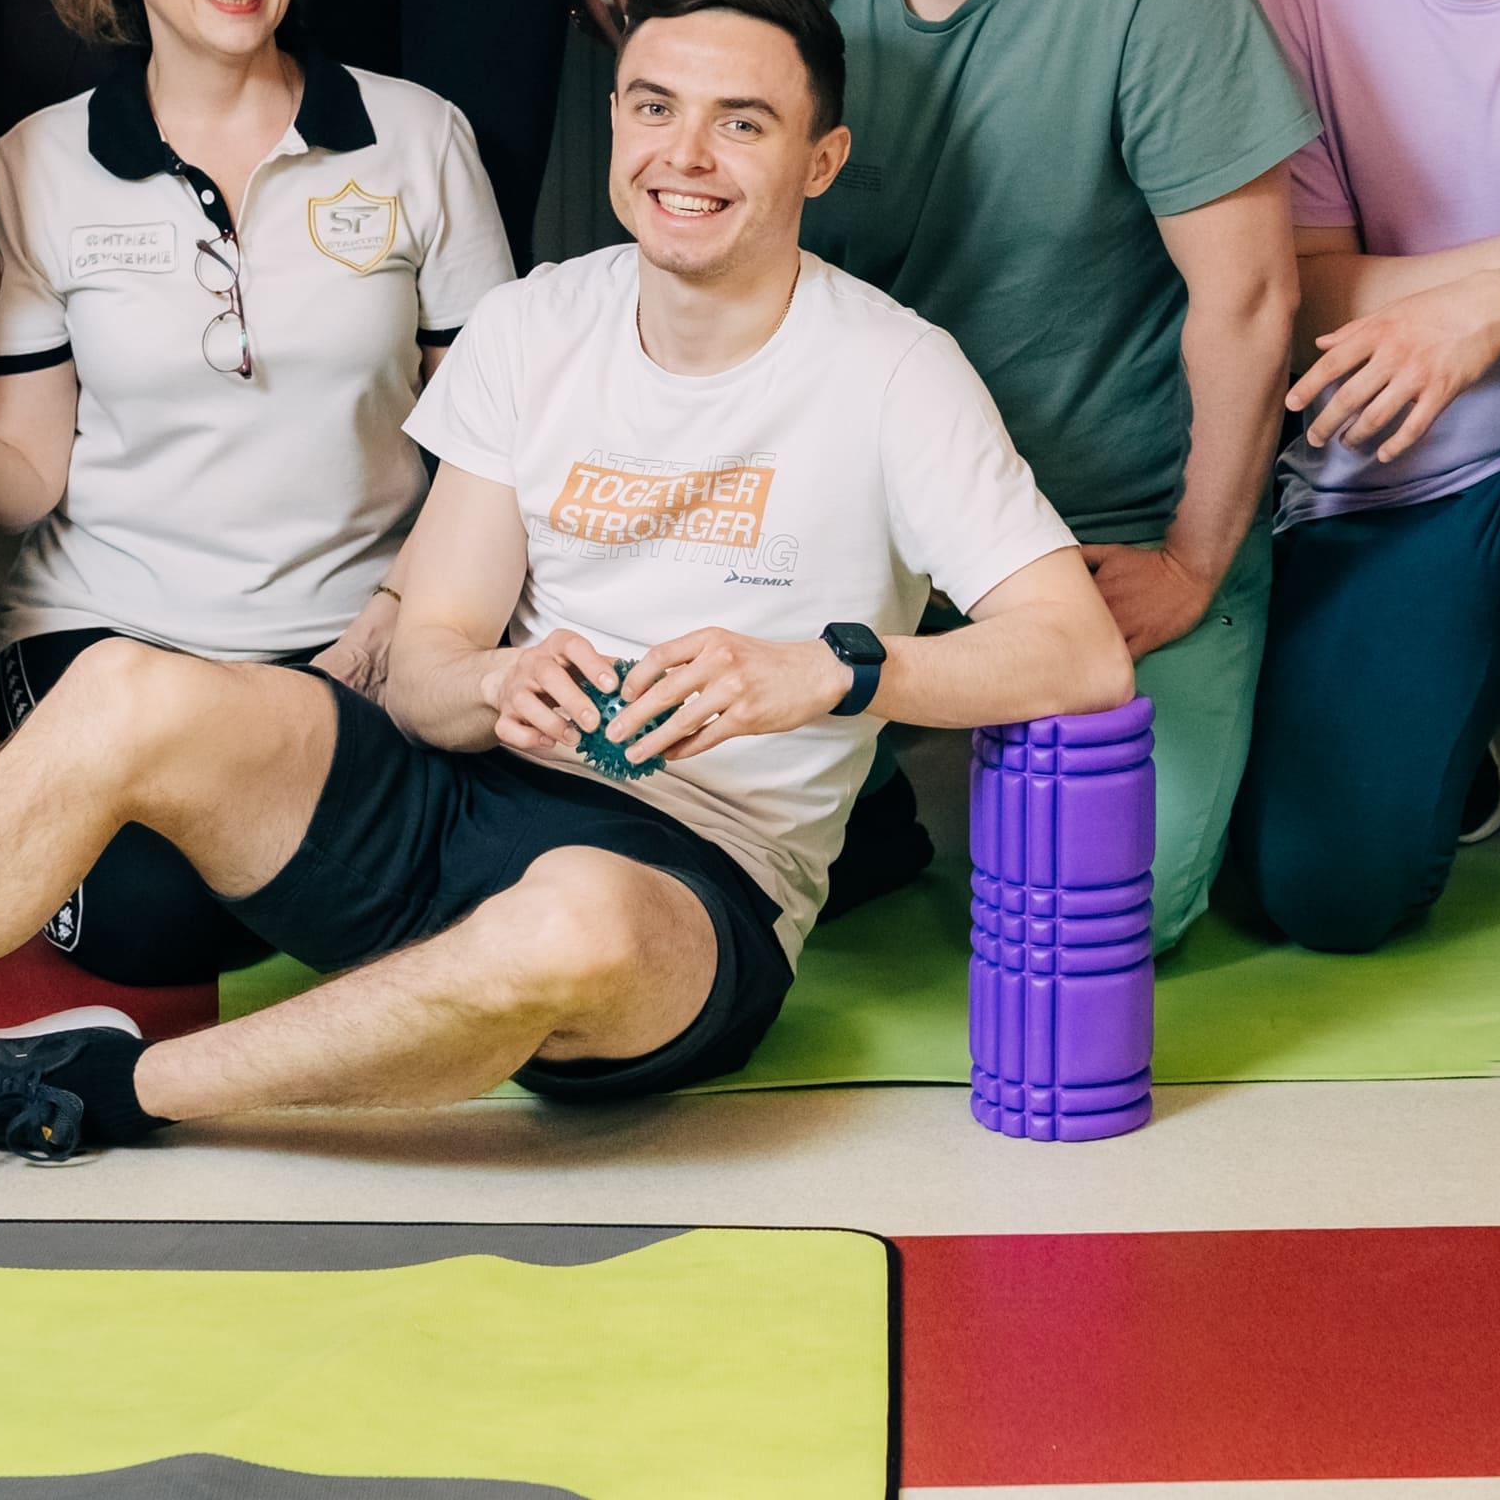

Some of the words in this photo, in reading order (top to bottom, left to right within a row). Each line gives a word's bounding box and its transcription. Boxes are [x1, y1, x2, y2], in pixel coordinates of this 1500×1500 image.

[574, 467, 761, 507] TOGETHER
[557, 503, 760, 544] STRONGER
[738, 575, 796, 588] DEMIX
